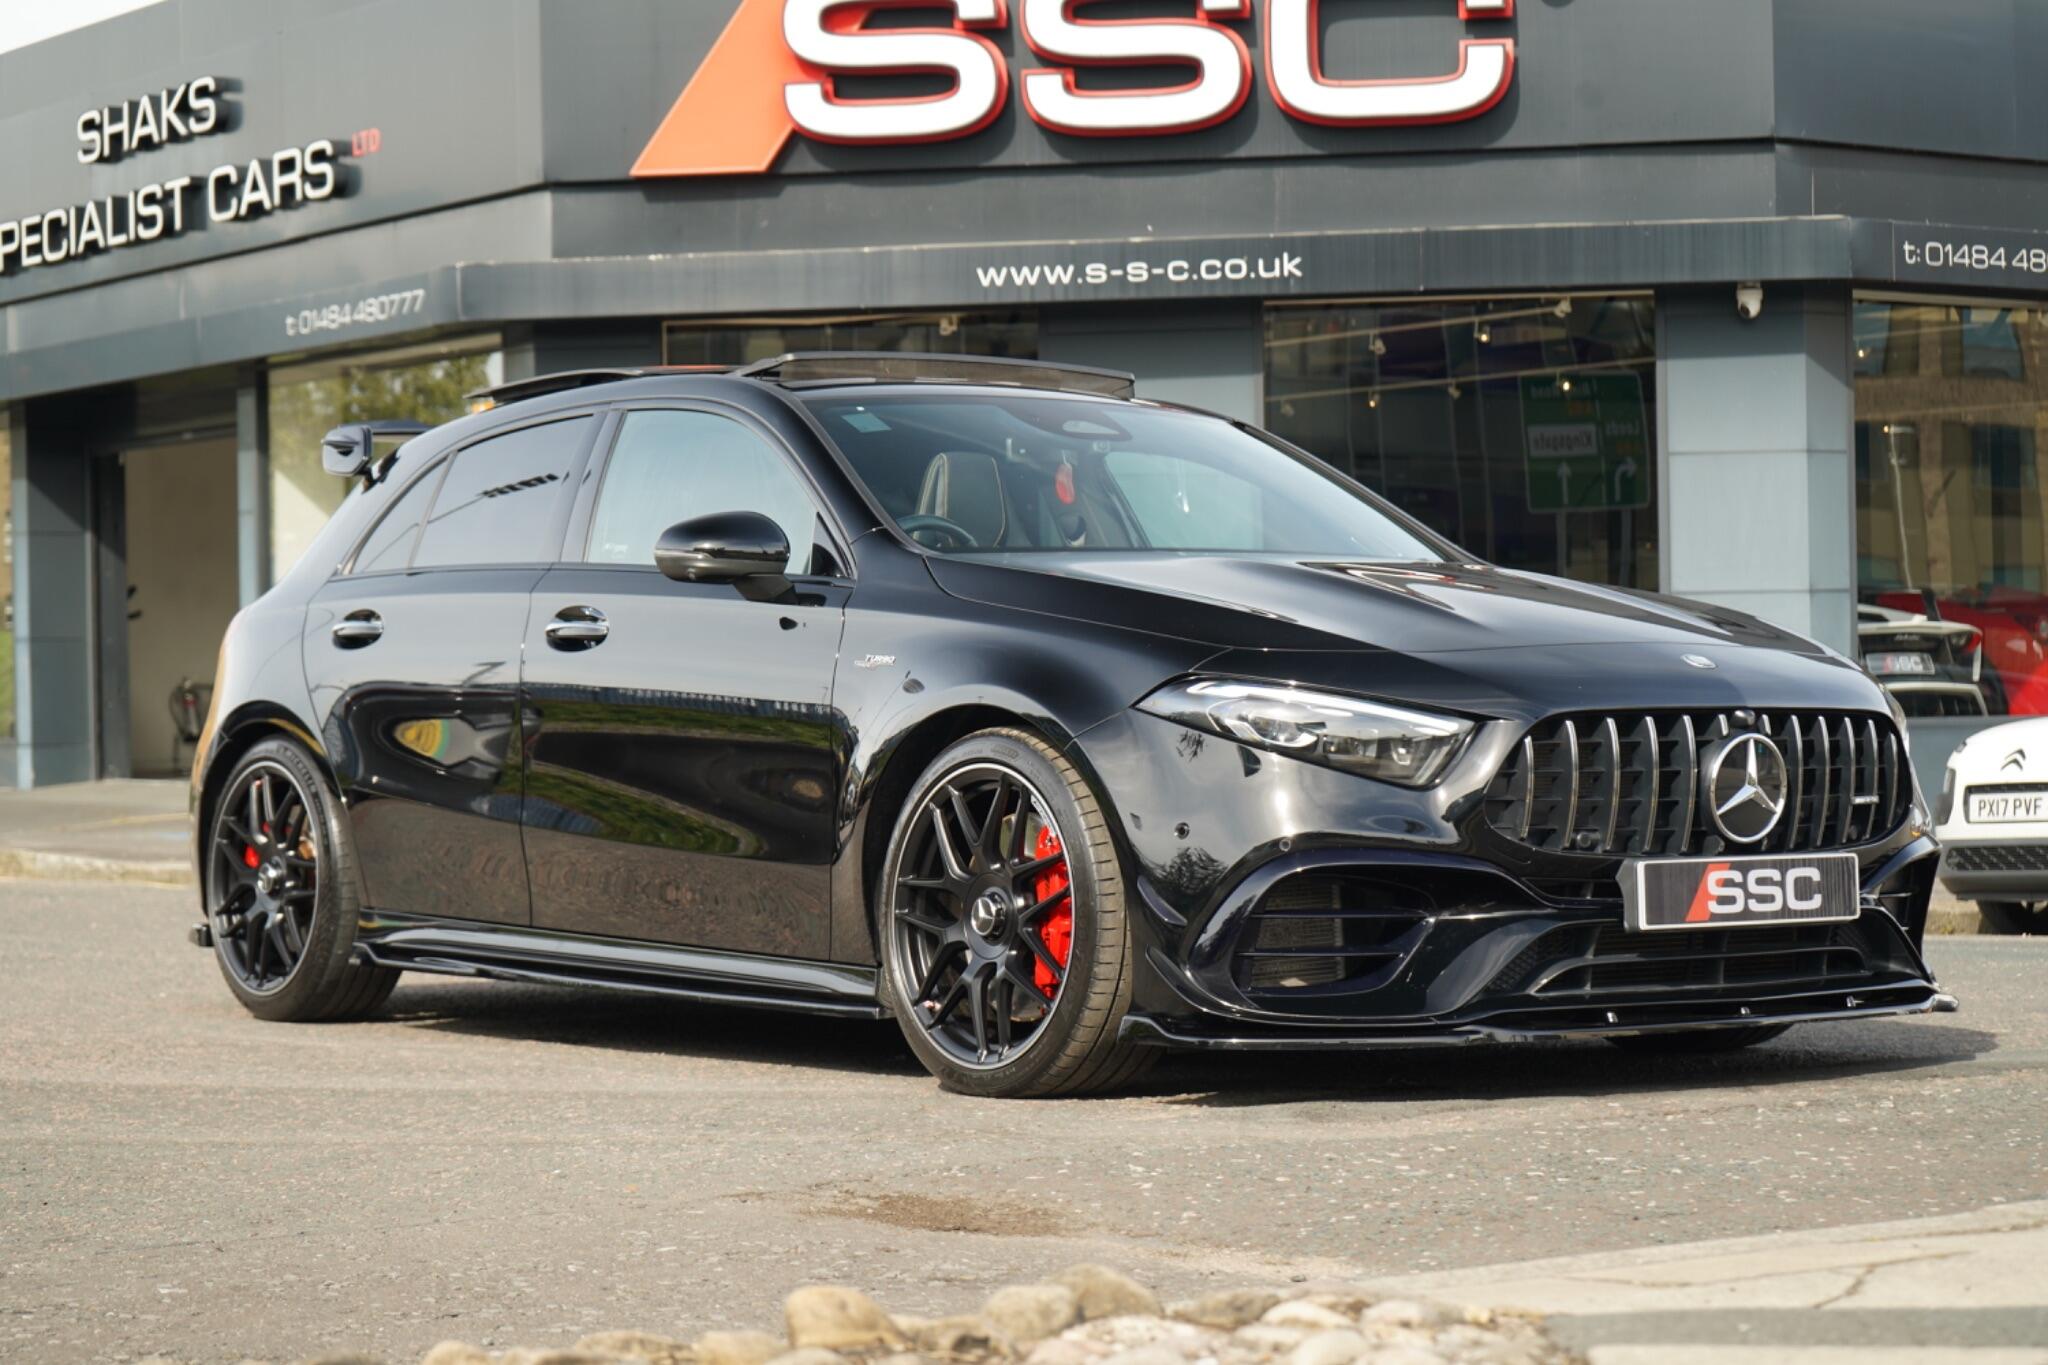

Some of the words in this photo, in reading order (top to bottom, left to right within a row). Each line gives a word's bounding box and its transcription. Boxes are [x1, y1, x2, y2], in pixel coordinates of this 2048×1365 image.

[783, 0, 1514, 146] SSC
[77, 75, 217, 164] SHAKS
[0, 176, 191, 271] PECIALIST
[207, 139, 335, 222] CARS
[351, 128, 381, 157] LTD
[976, 251, 1303, 287] www.s-s-c.co.uk
[2011, 248, 2048, 273] 48
[1978, 799, 2009, 817] PX17
[2013, 797, 2043, 817] PVF
[1707, 867, 1823, 914] SSC
